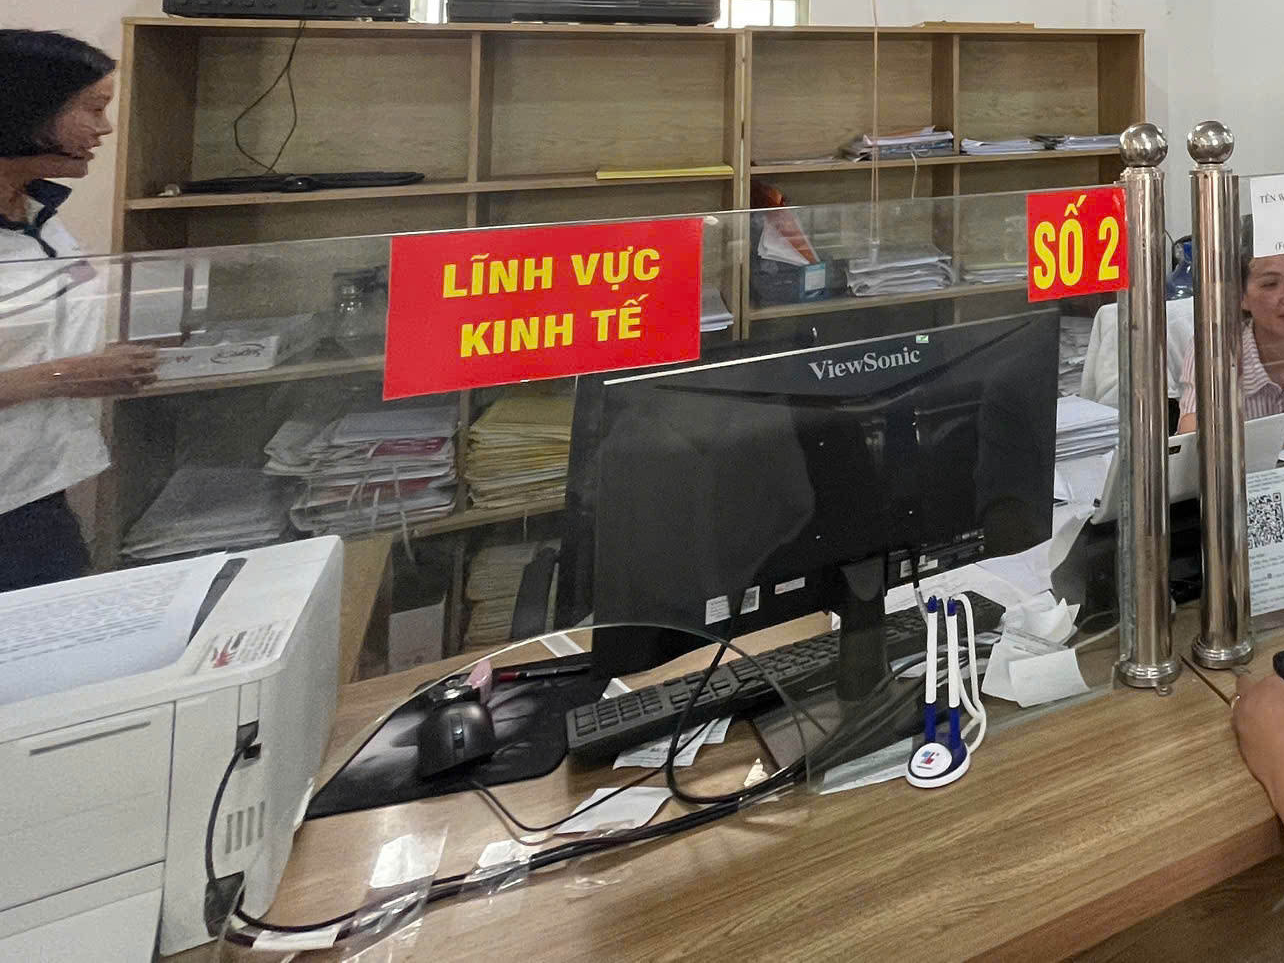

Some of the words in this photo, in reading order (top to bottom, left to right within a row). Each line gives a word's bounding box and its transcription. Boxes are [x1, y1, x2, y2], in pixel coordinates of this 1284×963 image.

[1033, 194, 1087, 290] SỐ
[1098, 216, 1120, 281] 2
[442, 254, 553, 299] LĨNH
[571, 245, 661, 292] VỰC
[460, 312, 574, 358] KINH
[591, 293, 650, 342] TẾ
[808, 347, 921, 381] ViewSonic
